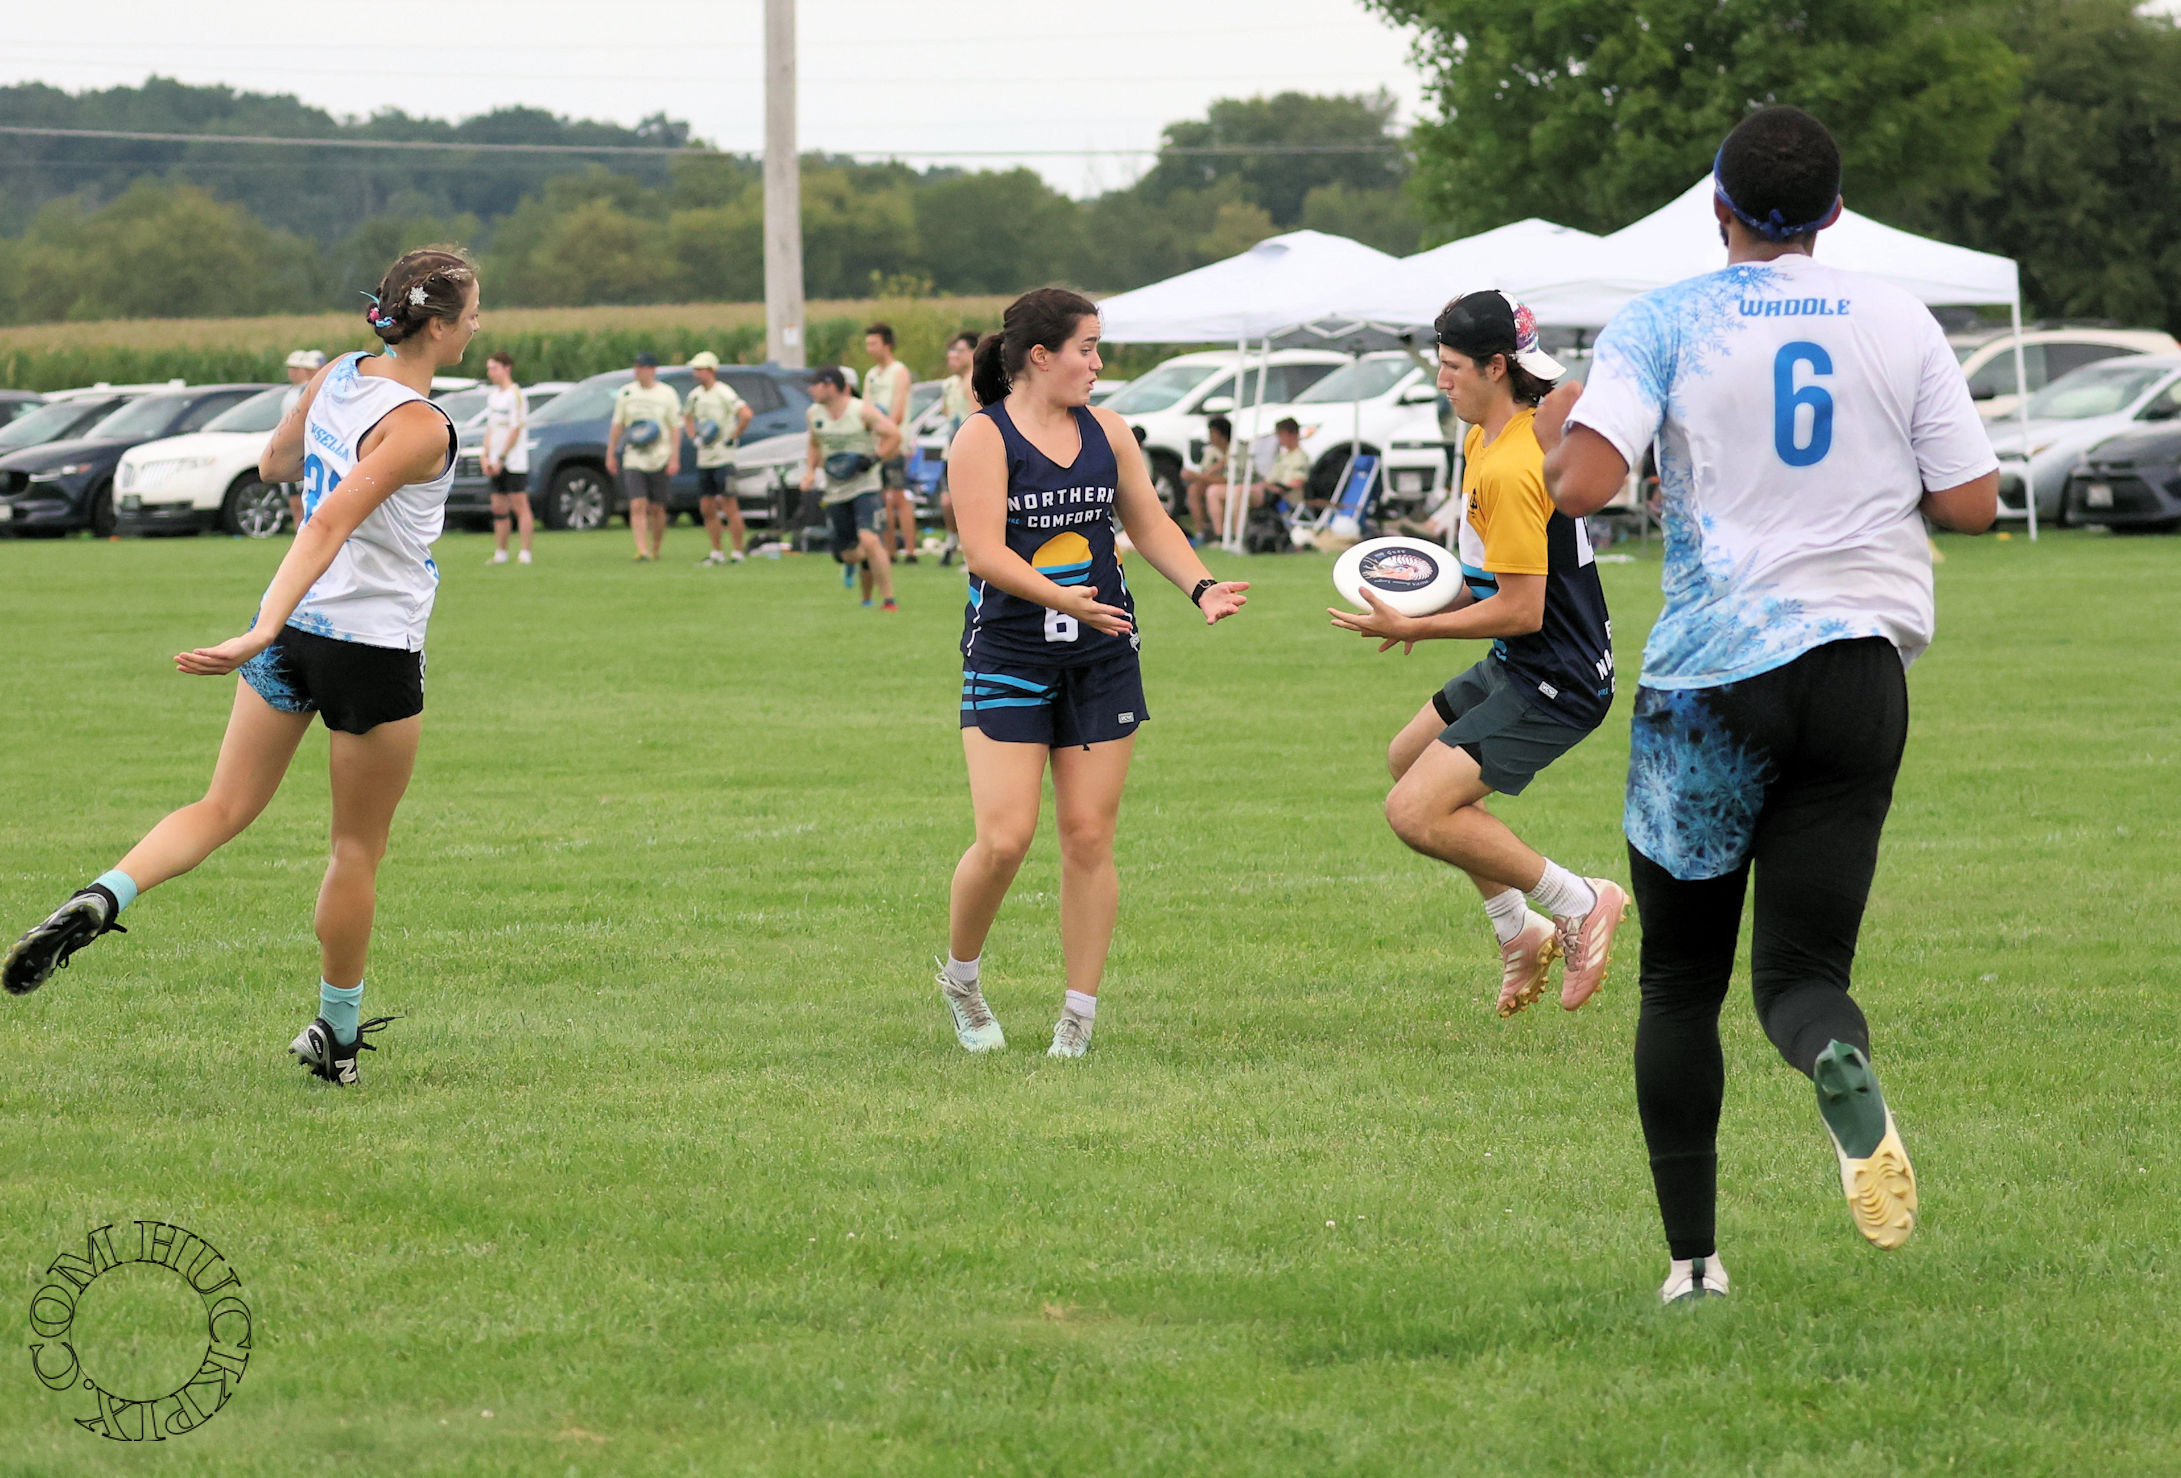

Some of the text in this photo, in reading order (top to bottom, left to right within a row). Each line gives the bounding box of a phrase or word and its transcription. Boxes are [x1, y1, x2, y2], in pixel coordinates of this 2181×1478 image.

[1738, 297, 1851, 317] WADDLE
[1773, 340, 1834, 467] 6
[1007, 486, 1115, 512] NORTHERN
[1027, 508, 1103, 528] COMFORT
[1043, 606, 1079, 642] 6
